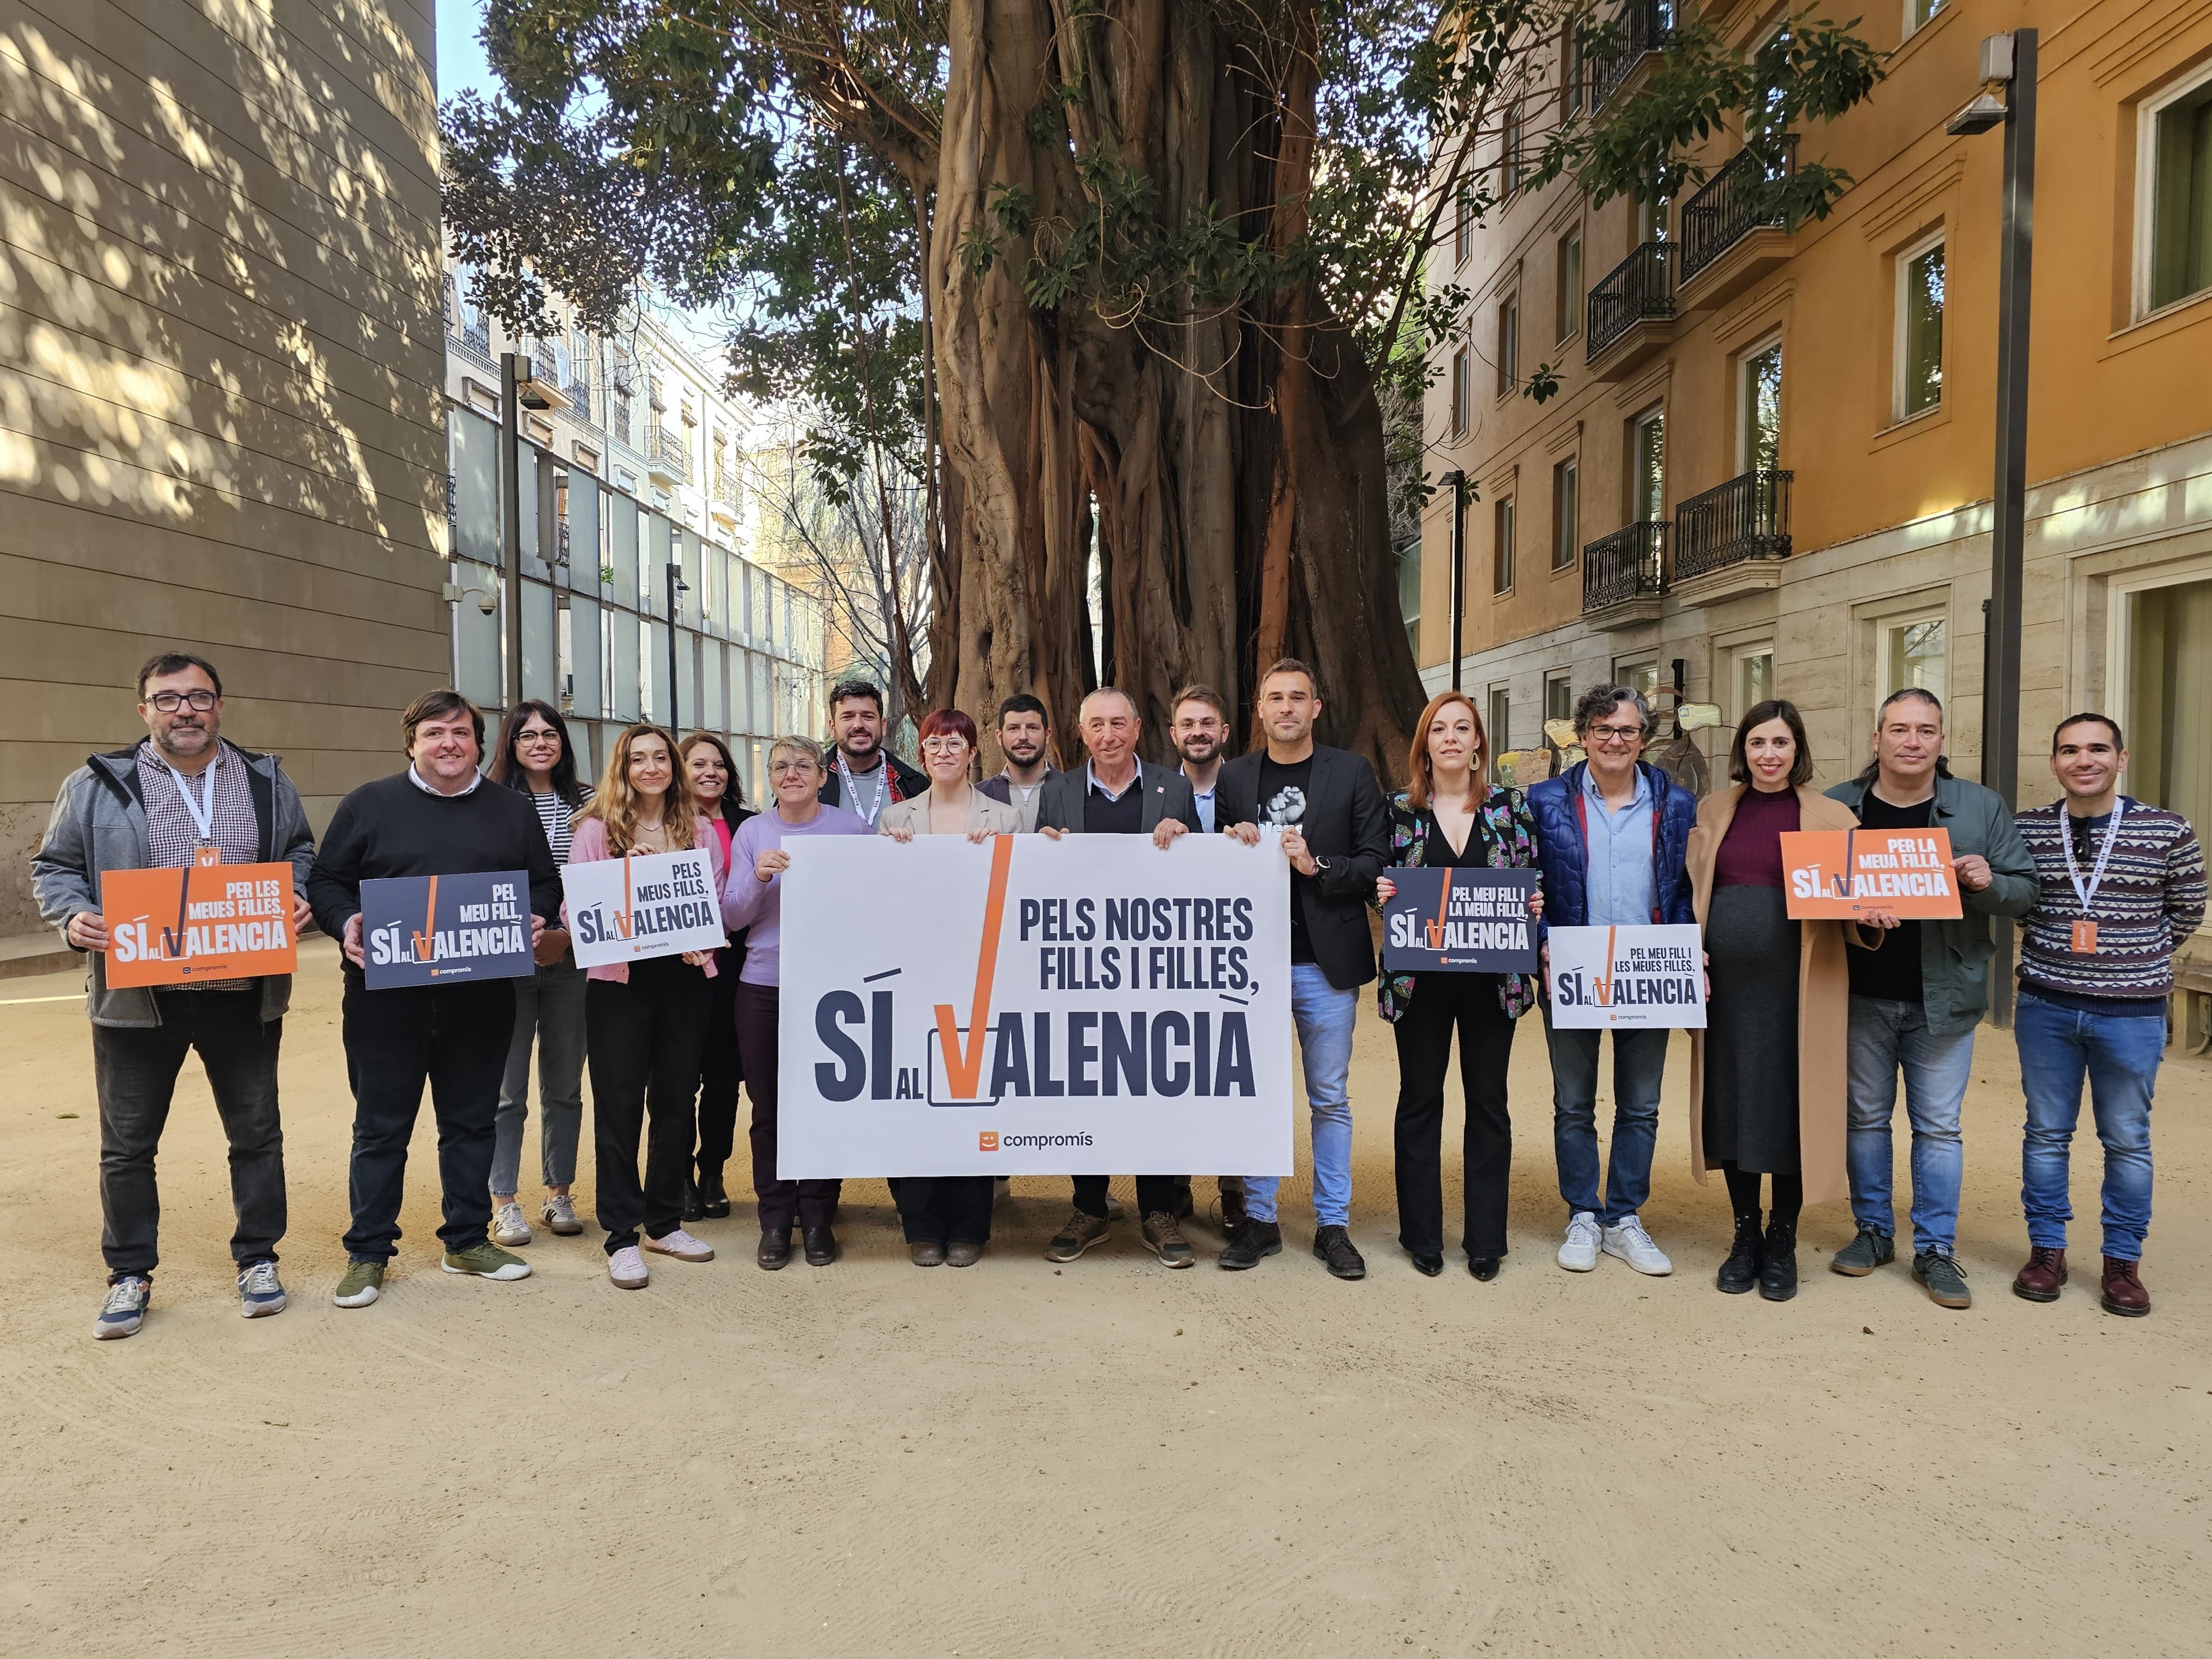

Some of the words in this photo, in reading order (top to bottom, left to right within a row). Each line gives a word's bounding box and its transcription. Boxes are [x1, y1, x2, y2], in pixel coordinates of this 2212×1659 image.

[1887, 839, 1915, 853] PER
[1918, 838, 1937, 852] LA
[672, 861, 701, 880] PELS
[1859, 854, 1900, 869] MEUA
[1901, 854, 1945, 869] FILLA,
[226, 882, 253, 899] PER
[256, 880, 279, 898] LES
[637, 883, 672, 902] MEUS
[673, 879, 709, 898] FILLS,
[1792, 864, 1821, 898] SÍ
[1821, 889, 1833, 897] AL
[1834, 869, 1950, 897] VALENCIÀ
[492, 883, 517, 901] PEL
[1452, 887, 1471, 901] PEL
[1473, 887, 1496, 901] MEU
[1499, 887, 1518, 902] FILL
[1521, 887, 1525, 902] I
[189, 901, 235, 920] MEUES
[238, 898, 285, 917] FILLES,
[460, 904, 489, 923] MEU
[492, 902, 522, 921] FILL,
[1449, 902, 1462, 916] LA
[1465, 902, 1495, 917] MEUA
[1496, 902, 1528, 919] FILLA,
[577, 902, 606, 944] SÍ
[606, 931, 615, 941] AL
[613, 897, 714, 938] VALENCIÀ
[1020, 897, 1096, 942] PELS
[1106, 897, 1253, 942] NOSTRES
[1391, 908, 1417, 948] SÍ
[1415, 937, 1425, 948] AL
[1426, 917, 1529, 950] VALENCIÀ
[115, 915, 149, 962] SÍ
[148, 948, 160, 960] AL
[163, 915, 287, 957] VALENCIÀ
[370, 920, 401, 965] SÍ
[401, 951, 412, 963] AL
[412, 921, 526, 961] VALENCIÀ
[642, 942, 669, 950] compromís
[1631, 948, 1646, 959] PEL
[1649, 948, 1667, 959] MEU
[1669, 948, 1686, 958] FILL
[1689, 948, 1691, 958] I
[192, 964, 227, 973] compromís
[440, 966, 471, 975] compromís
[1041, 946, 1121, 990] FILLS
[1131, 947, 1140, 990] I
[1150, 946, 1260, 996] FILLES,
[1615, 961, 1630, 972] LES
[1633, 960, 1661, 972] MEUES
[1664, 960, 1695, 972] FILLES,
[1558, 967, 1584, 1005] SÍ
[1584, 996, 1592, 1005] AL
[1594, 973, 1697, 1005] VALENCIÀ
[814, 968, 902, 1102] SÍ
[896, 1067, 924, 1100] AL
[933, 994, 1256, 1100] VALENCIÀ
[1003, 1131, 1093, 1149] compromís
